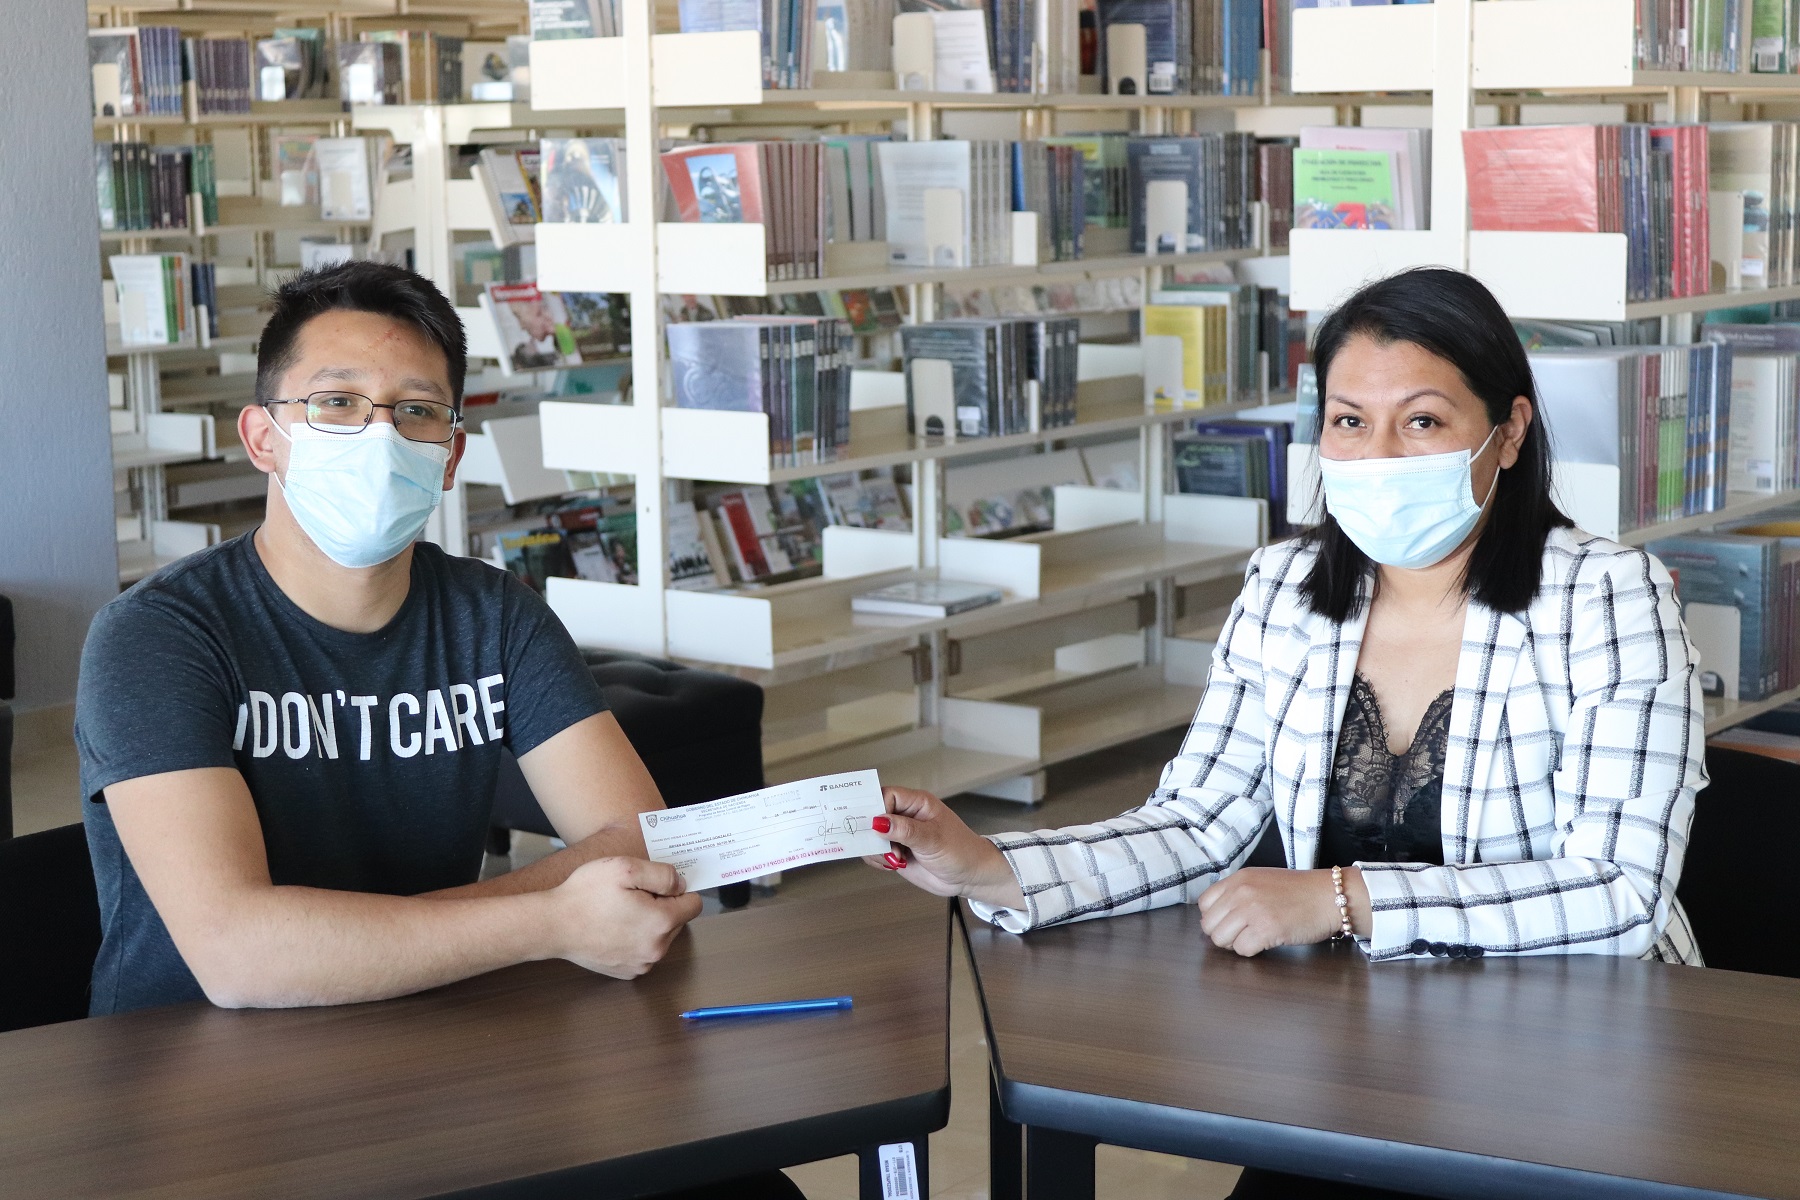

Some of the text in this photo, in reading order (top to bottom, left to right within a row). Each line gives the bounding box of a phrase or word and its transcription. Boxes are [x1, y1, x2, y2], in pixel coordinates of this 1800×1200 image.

[249, 690, 378, 760] DON'T
[389, 673, 505, 758] CARE
[829, 781, 862, 790] BANORTE
[660, 813, 687, 822] Chihuahua
